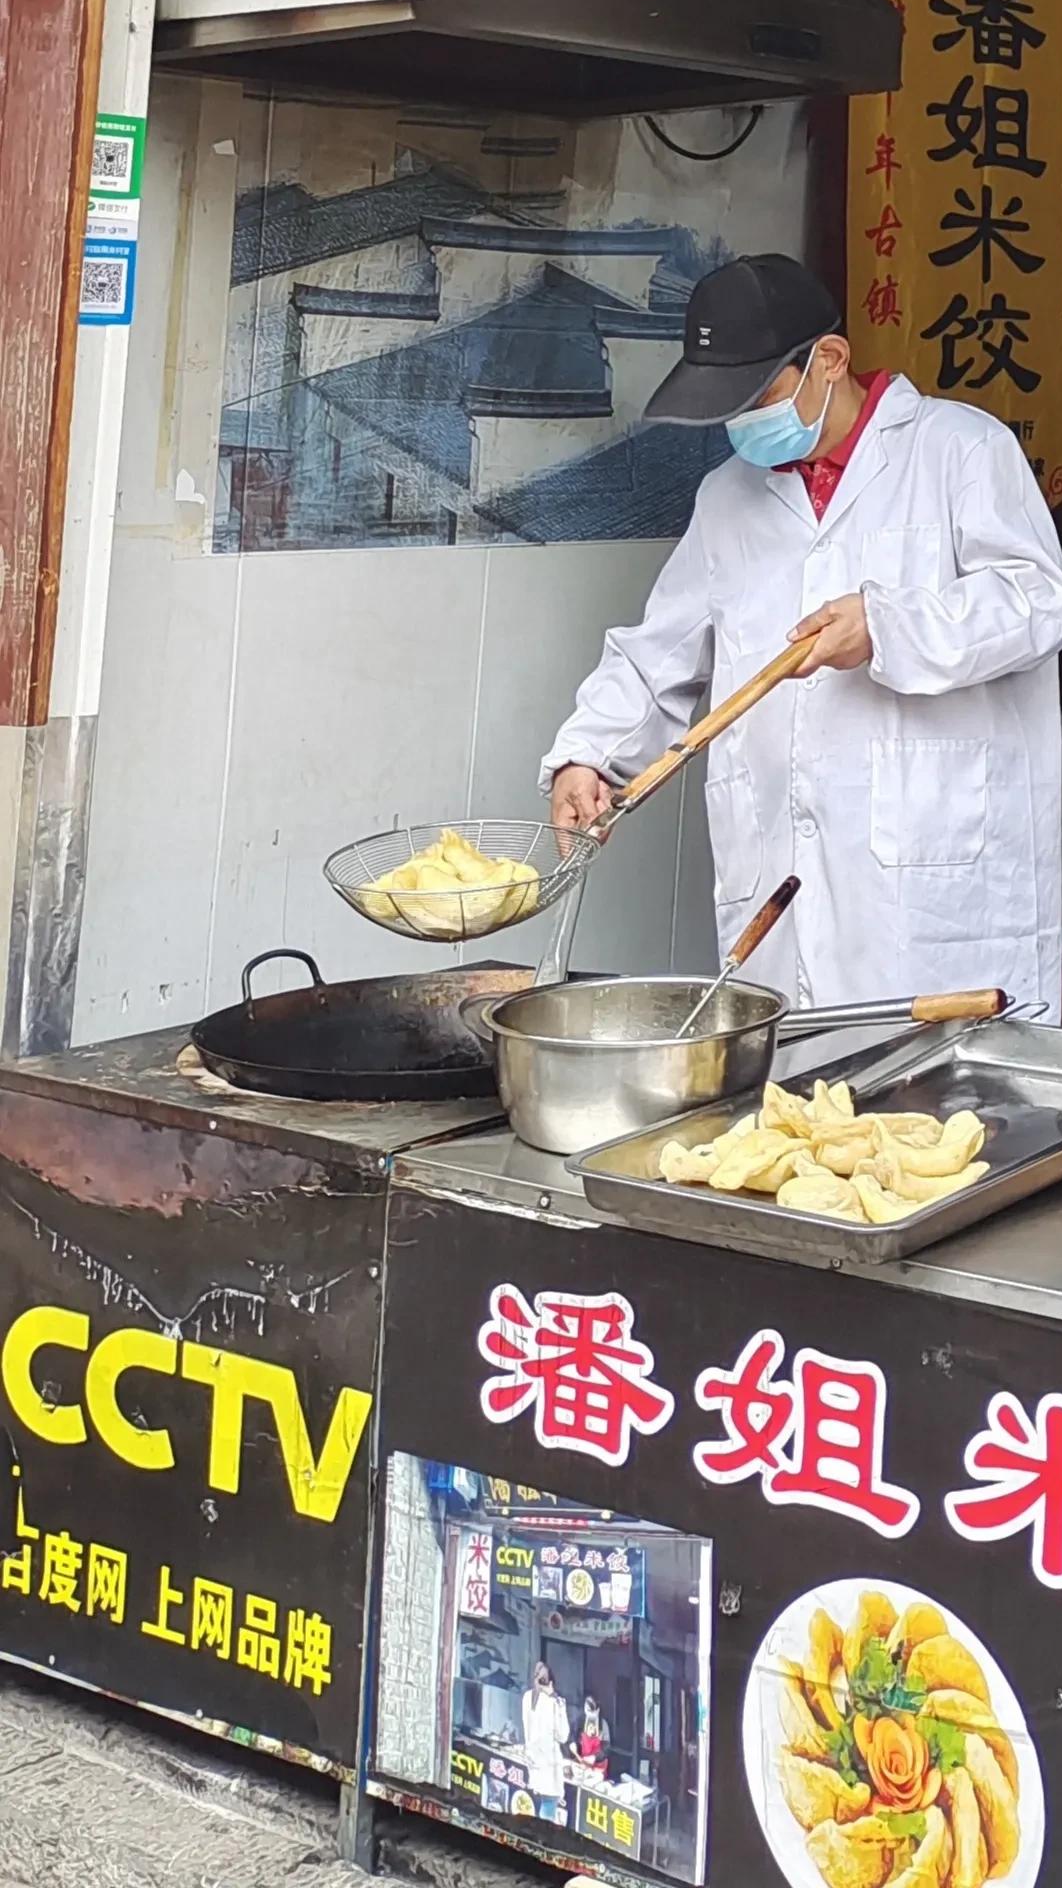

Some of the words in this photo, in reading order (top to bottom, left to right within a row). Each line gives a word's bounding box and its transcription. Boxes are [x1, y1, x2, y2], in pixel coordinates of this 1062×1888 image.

[2, 1306, 373, 1523] CCTV
[464, 1532, 493, 1614] 米饺
[496, 1545, 534, 1570] CCTV
[141, 1565, 332, 1696] 上网品牌
[585, 1796, 635, 1848] 出售
